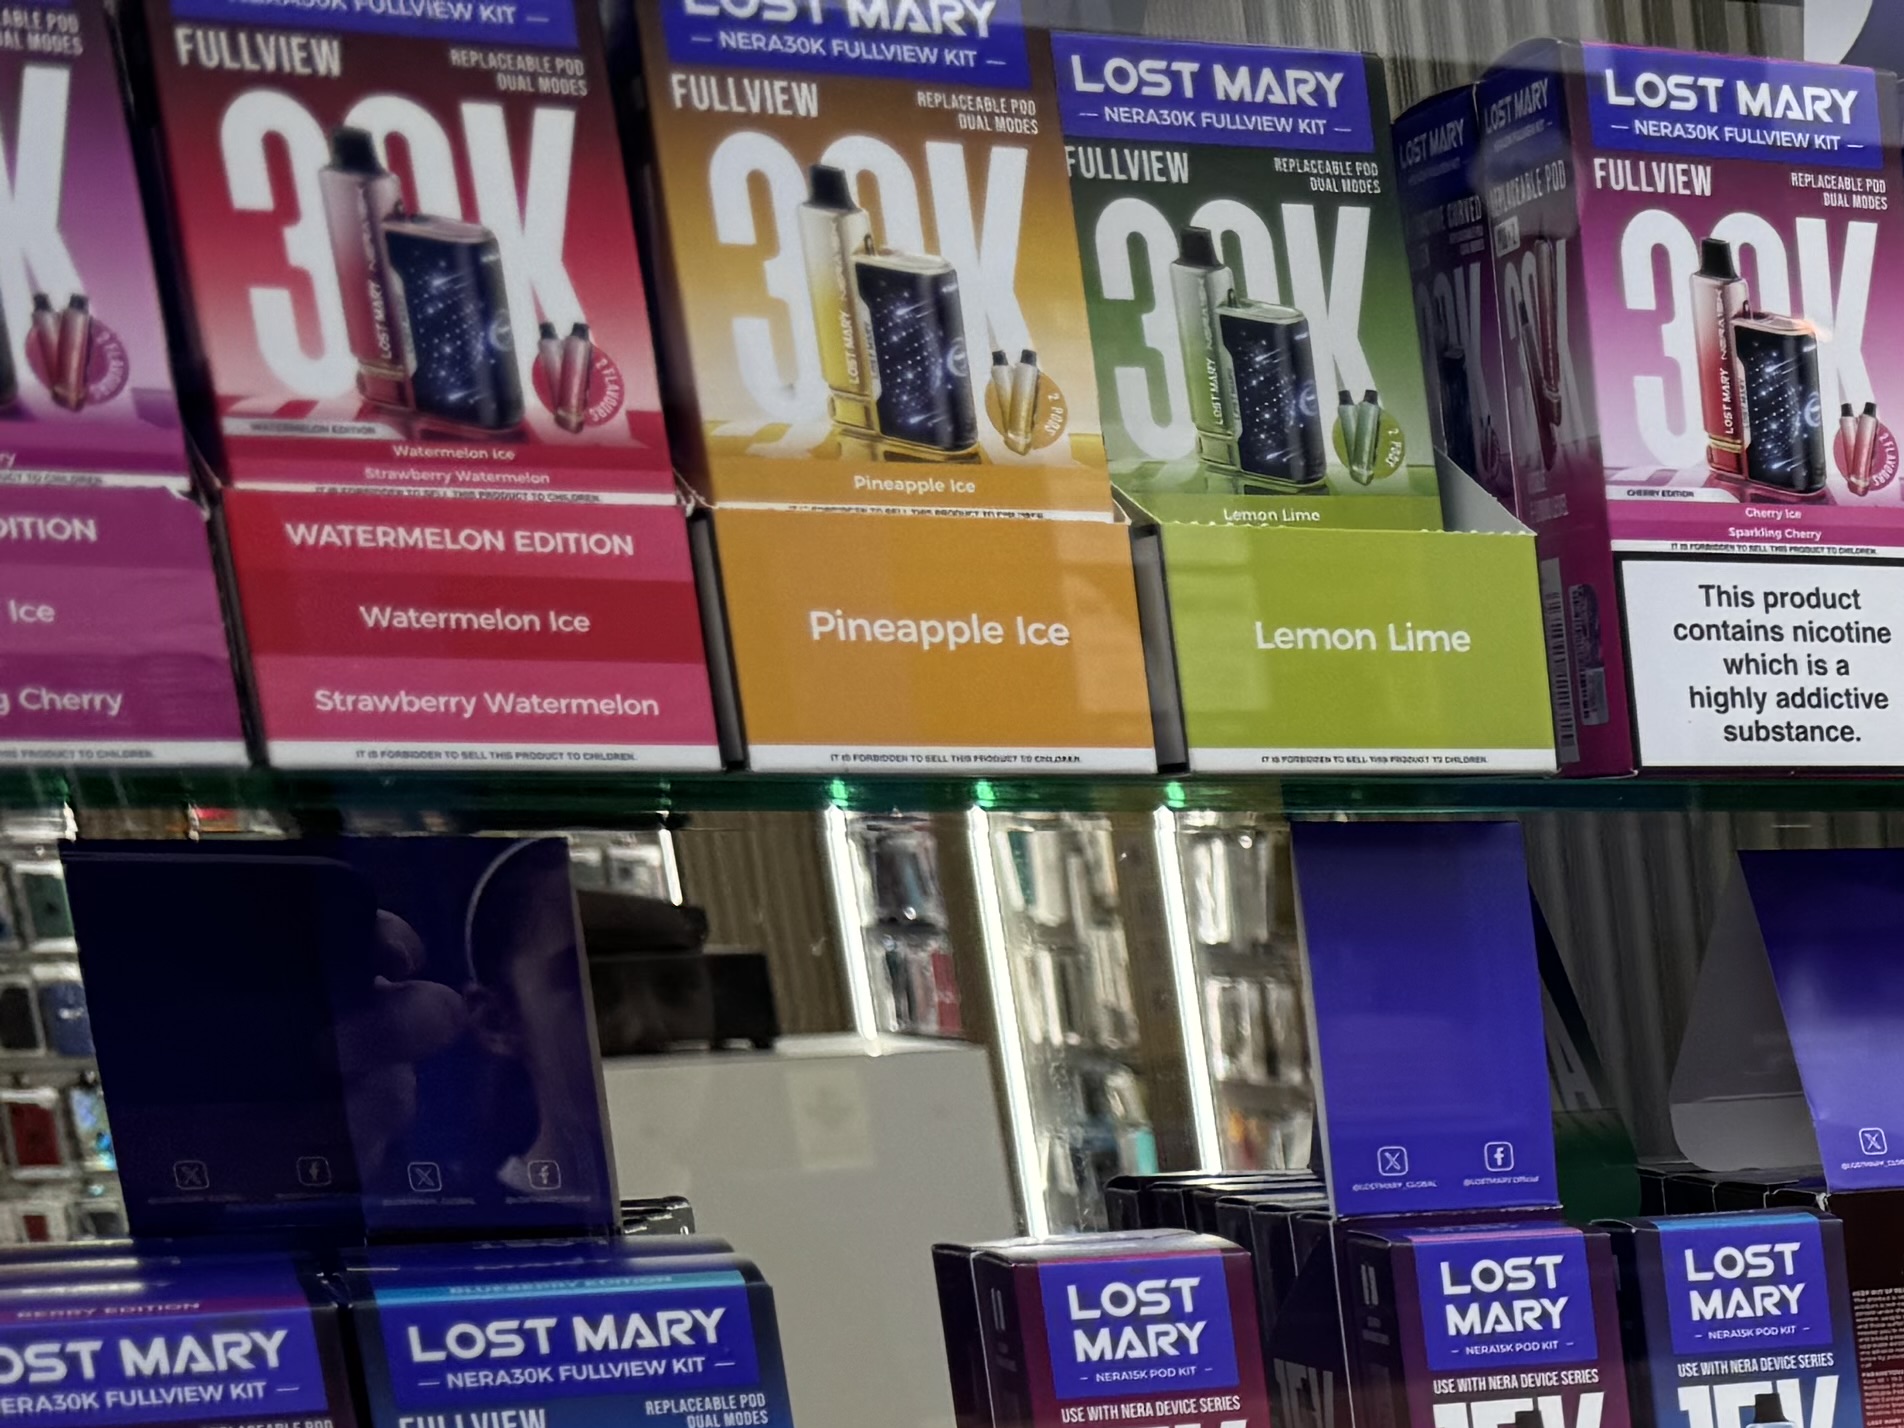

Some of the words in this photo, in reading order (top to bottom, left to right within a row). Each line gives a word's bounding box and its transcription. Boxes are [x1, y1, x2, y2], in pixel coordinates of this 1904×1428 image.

[175, 27, 340, 76] FULLVIEW
[1071, 55, 1199, 98] LOST
[1213, 64, 1343, 107] MARY
[1605, 69, 1724, 112] LOST
[1737, 81, 1857, 124] MARY
[1635, 120, 1719, 140] NERA30K
[1724, 127, 1810, 147] FULLVIEW
[1814, 134, 1840, 150] KIT
[1594, 158, 1711, 196] FULLVIEW
[1791, 173, 1863, 191] REPLACEABLE
[1866, 179, 1885, 193] POD
[1824, 192, 1849, 207] DUAL
[1853, 195, 1887, 209] MODES
[286, 524, 504, 551] WATERMELON
[515, 531, 633, 555] EDITION
[1698, 585, 1755, 608] This
[1764, 587, 1861, 614] product
[810, 609, 1003, 650] Pineapple
[1017, 617, 1069, 645] Ice
[1255, 621, 1376, 650] Lemon
[1389, 624, 1470, 652] Lime
[1674, 619, 1784, 641] contains
[1793, 621, 1891, 643] nicotine
[1723, 653, 1798, 675] which
[1807, 654, 1828, 675] is
[1837, 659, 1849, 675] a
[1689, 686, 1767, 714] highly
[1776, 687, 1888, 709] addictive
[1724, 720, 1861, 742] substance.
[1067, 1277, 1200, 1319] LOST
[1074, 1321, 1206, 1362] MARY
[1061, 1406, 1085, 1423] USE
[1087, 1404, 1119, 1421] WITH
[1121, 1402, 1152, 1418] NERA
[1155, 1399, 1197, 1416] DEVICE
[1200, 1395, 1241, 1412] SERIES
